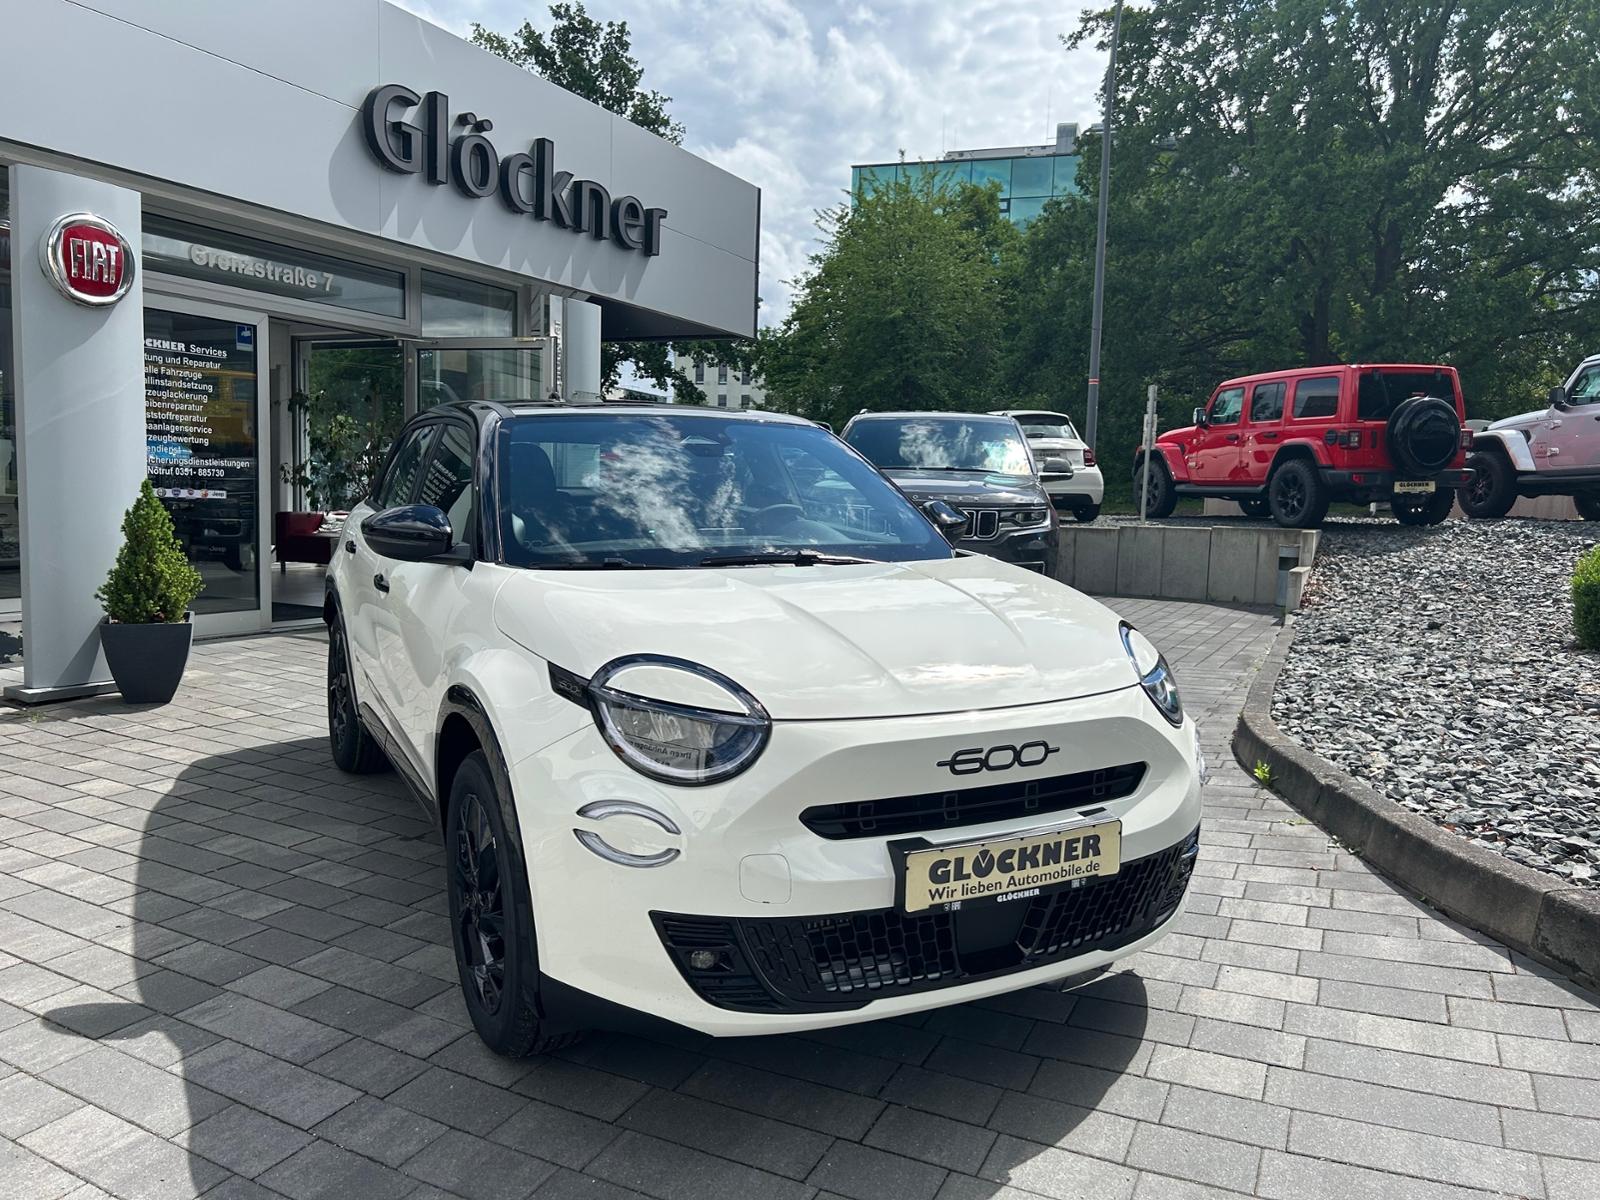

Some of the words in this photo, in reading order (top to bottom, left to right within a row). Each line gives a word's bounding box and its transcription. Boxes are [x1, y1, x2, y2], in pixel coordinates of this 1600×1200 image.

[363, 84, 668, 257] Glöckner
[70, 237, 119, 284] FIAT
[189, 243, 317, 289] Grenzstraße
[321, 271, 334, 292] 7
[144, 338, 186, 352] CKNER
[190, 344, 228, 357] Services
[144, 353, 163, 364] tung
[165, 355, 181, 365] und
[183, 357, 221, 369] Reparatur
[160, 366, 203, 380] Fahrzeuge
[144, 376, 213, 393] allinstandsetzung
[145, 399, 204, 412] eibenreparatur
[146, 411, 208, 423] ststoffreparatur
[148, 455, 250, 469] icherungsdienstleistungen
[937, 740, 1061, 776] 600
[928, 834, 1101, 885] GLÖCKNER
[928, 884, 957, 901] Wir
[961, 879, 1002, 897] lieben
[1006, 861, 1100, 889] Automobile.de
[996, 888, 1040, 903] GLÖCKNER
